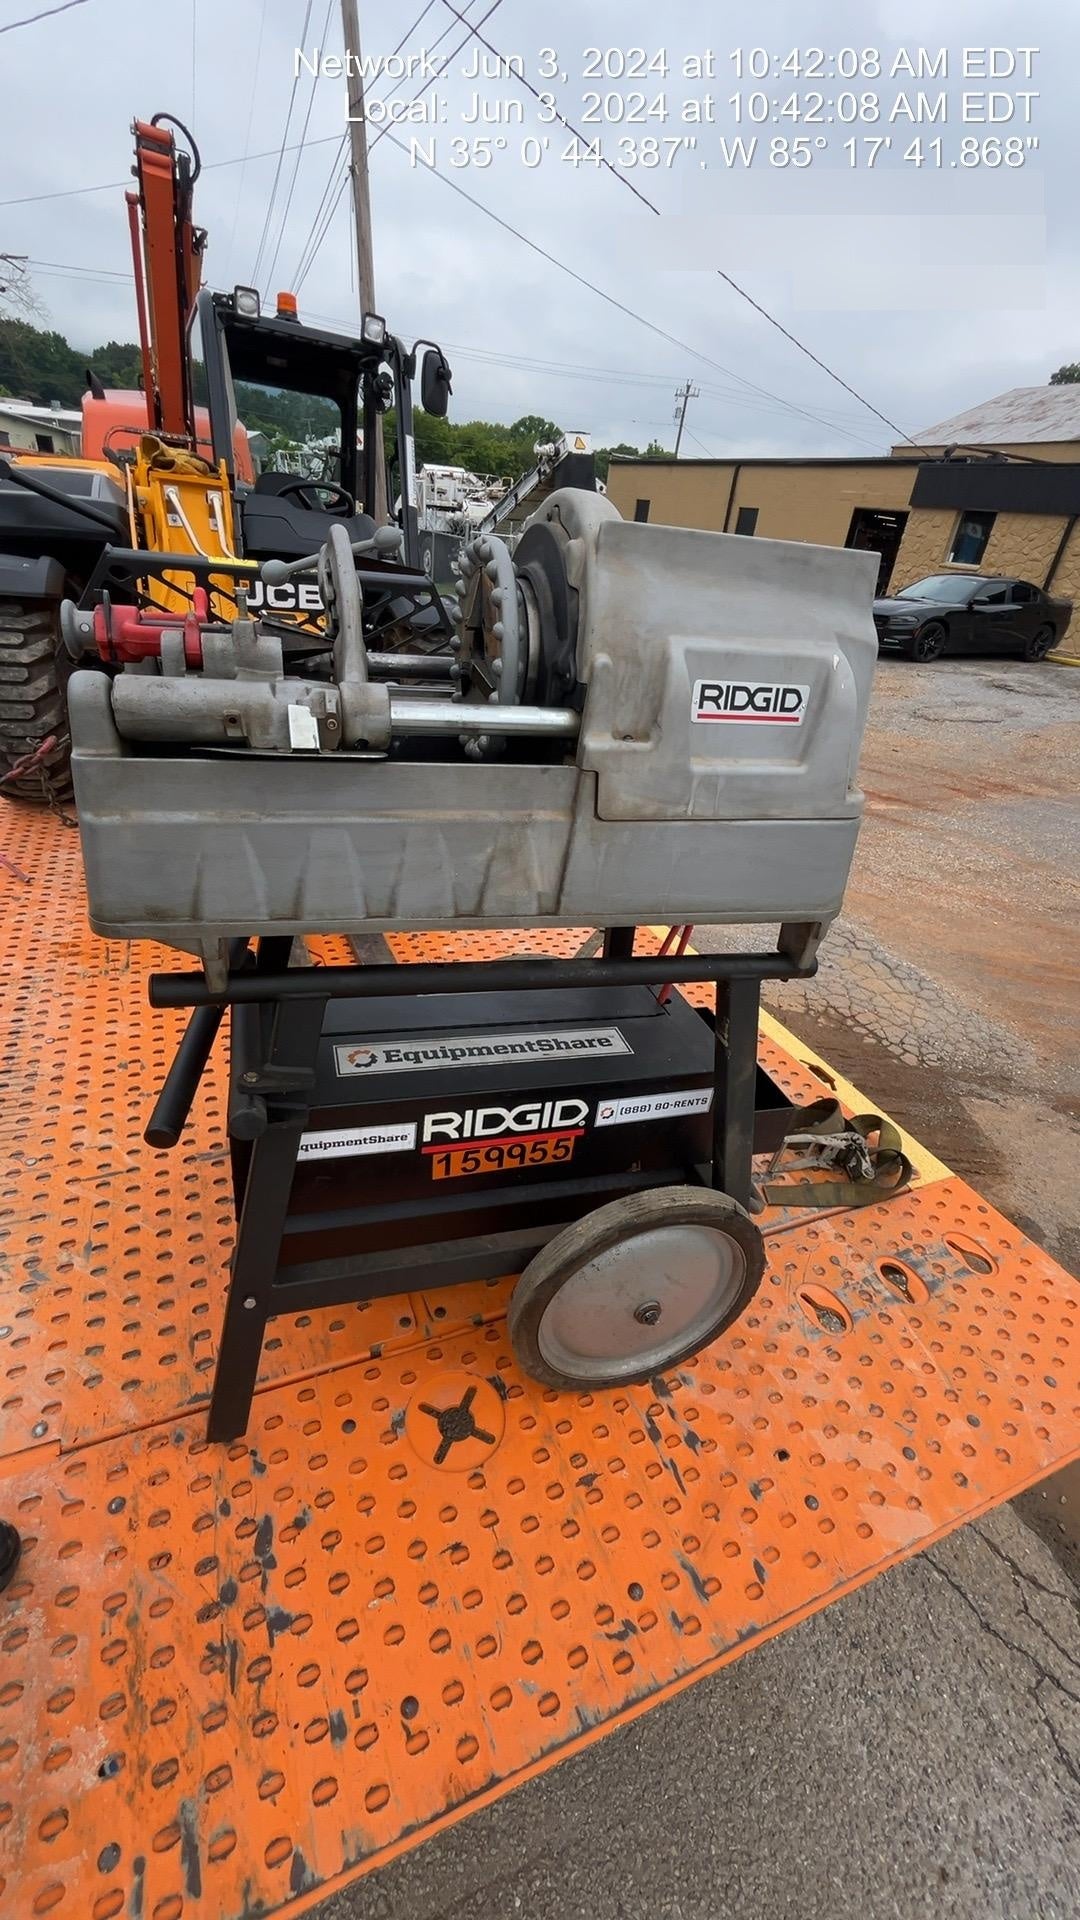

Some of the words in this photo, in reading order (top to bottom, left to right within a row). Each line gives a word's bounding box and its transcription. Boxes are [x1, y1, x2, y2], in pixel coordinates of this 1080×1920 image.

[246, 581, 326, 610] JCB
[698, 683, 803, 713] RIDGID
[383, 1036, 614, 1064] EquipmentShare
[422, 1099, 590, 1143] RIDGID
[300, 1134, 409, 1152] quipmentShare
[436, 1137, 572, 1177] 159955
